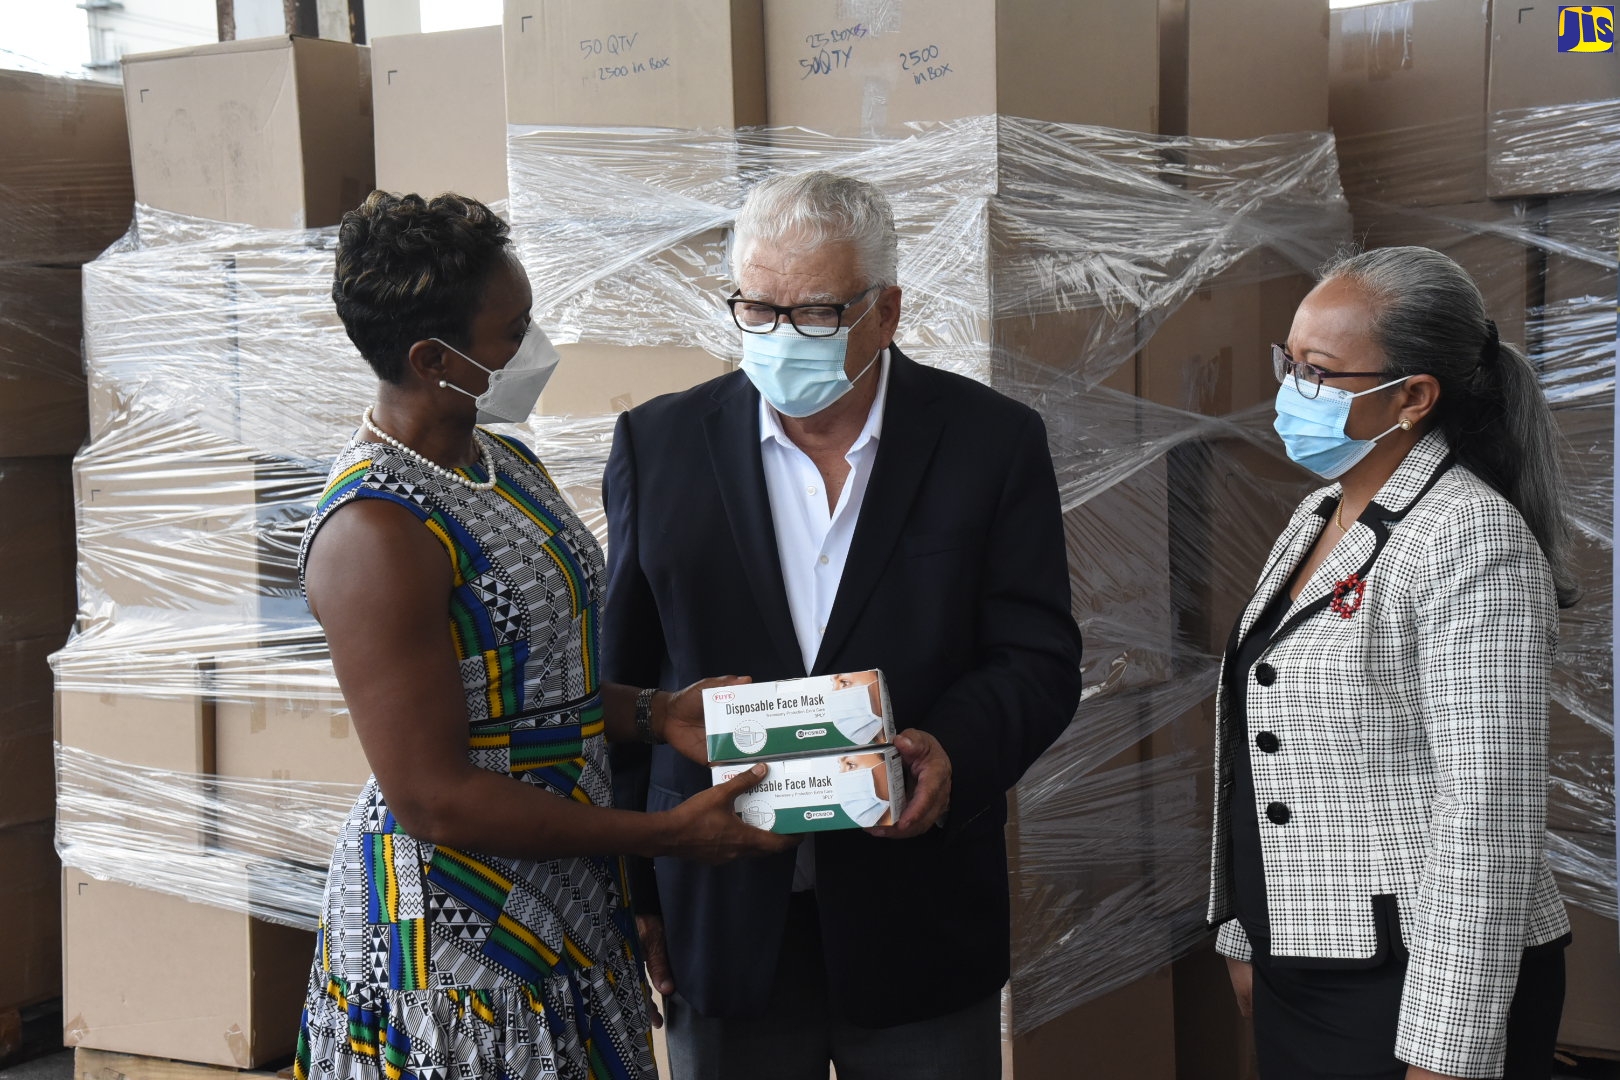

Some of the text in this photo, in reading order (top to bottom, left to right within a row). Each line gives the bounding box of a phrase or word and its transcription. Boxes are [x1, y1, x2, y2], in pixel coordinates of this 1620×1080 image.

[580, 38, 602, 60] 50
[899, 44, 938, 70] 2500
[598, 65, 628, 80] 2500
[725, 693, 825, 716] Disposable Face Mask
[785, 777, 807, 791] Face
[808, 775, 833, 789] Mask
